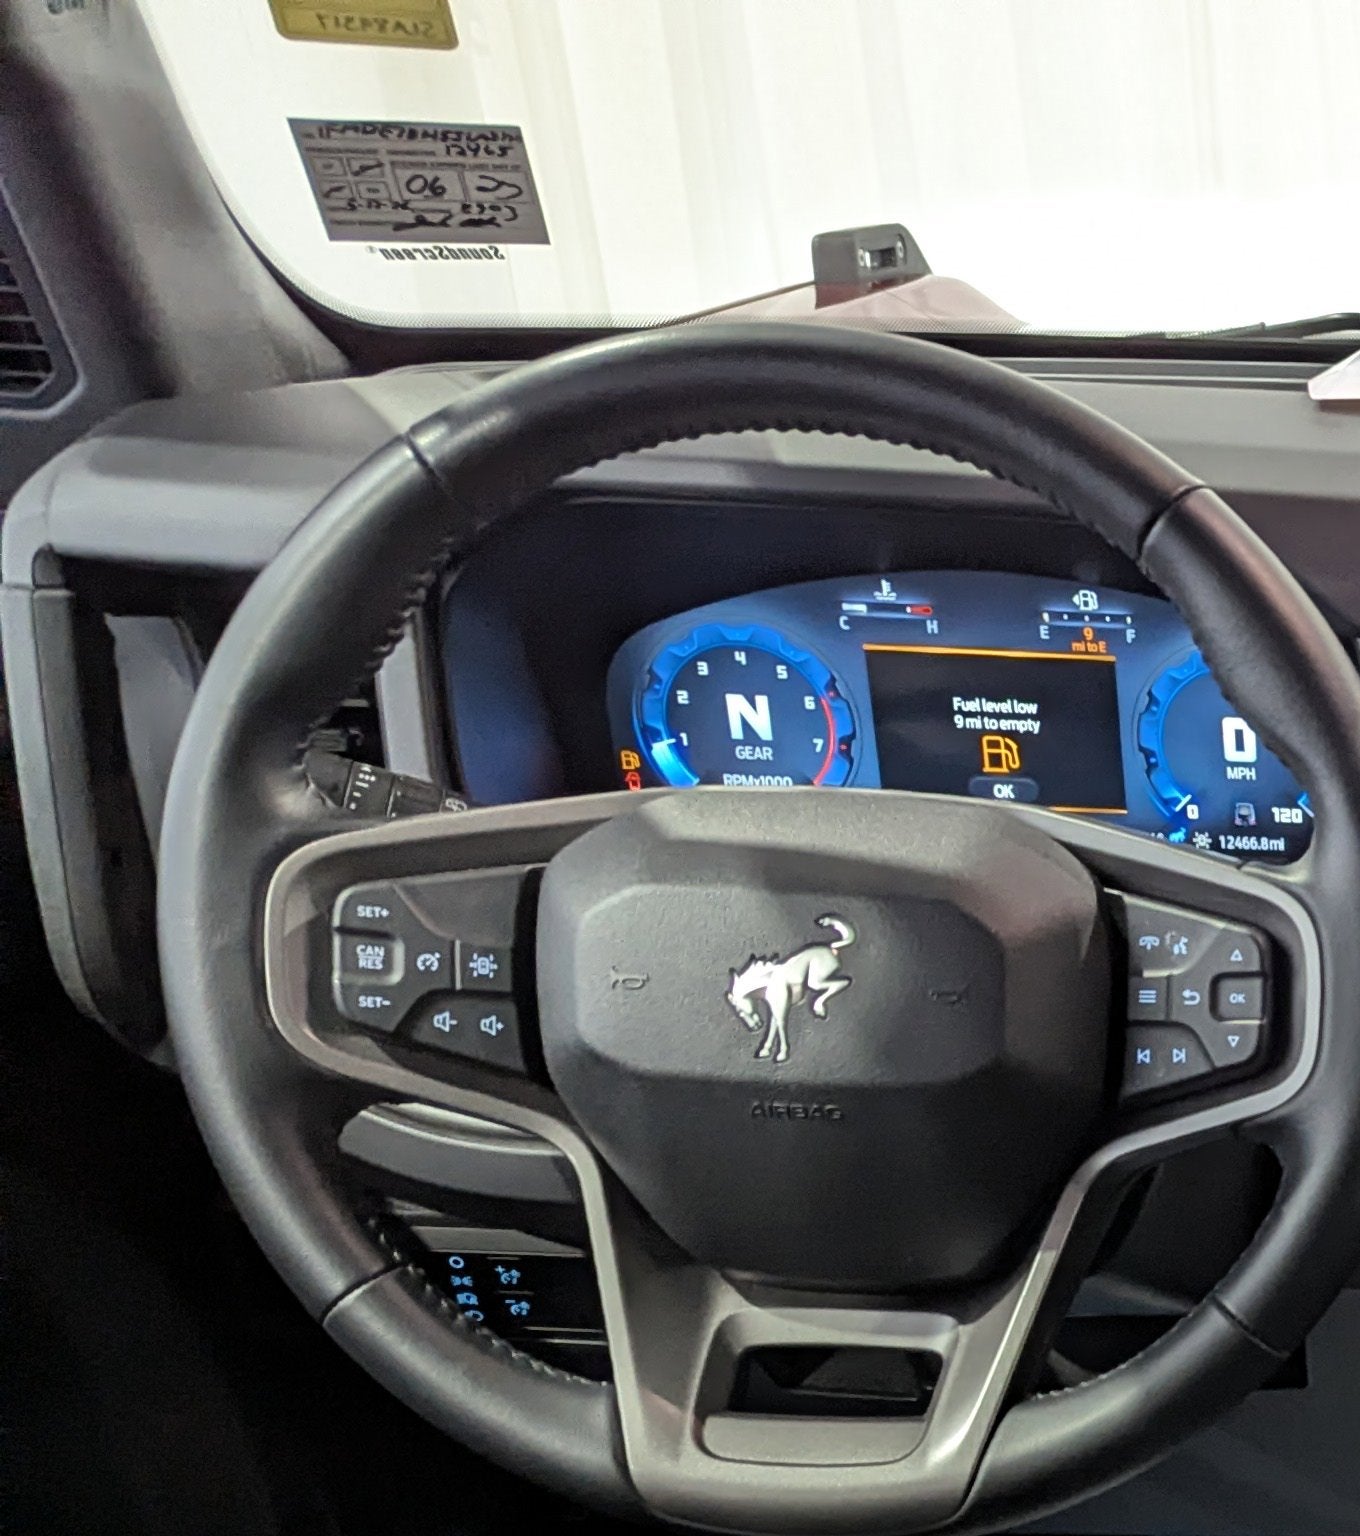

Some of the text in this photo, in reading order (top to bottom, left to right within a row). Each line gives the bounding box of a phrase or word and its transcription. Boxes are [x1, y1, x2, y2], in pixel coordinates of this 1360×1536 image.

[839, 616, 850, 631] C
[926, 620, 938, 634] H
[1039, 624, 1050, 640] E
[1082, 627, 1094, 640] 9
[1126, 629, 1136, 644] F
[1085, 641, 1098, 652] to
[1098, 642, 1107, 653] E
[734, 651, 746, 665] 4
[697, 662, 709, 676] 3
[776, 665, 788, 680] 5
[677, 690, 689, 704] 2
[804, 696, 815, 711] 6
[952, 697, 1038, 715] Fuel level low
[725, 693, 773, 741] N
[954, 715, 1040, 734] 9 mi to empty
[679, 732, 688, 746] 1
[813, 738, 823, 753] 7
[735, 746, 773, 761] GEAR
[1226, 766, 1256, 781] MPH
[993, 784, 1015, 799] OK
[1187, 804, 1199, 820] 0
[1272, 806, 1303, 824] 120
[356, 945, 385, 957] CAN
[358, 958, 383, 970] RES
[1230, 993, 1246, 1004] OK
[751, 1100, 844, 1121] AIRBAG
